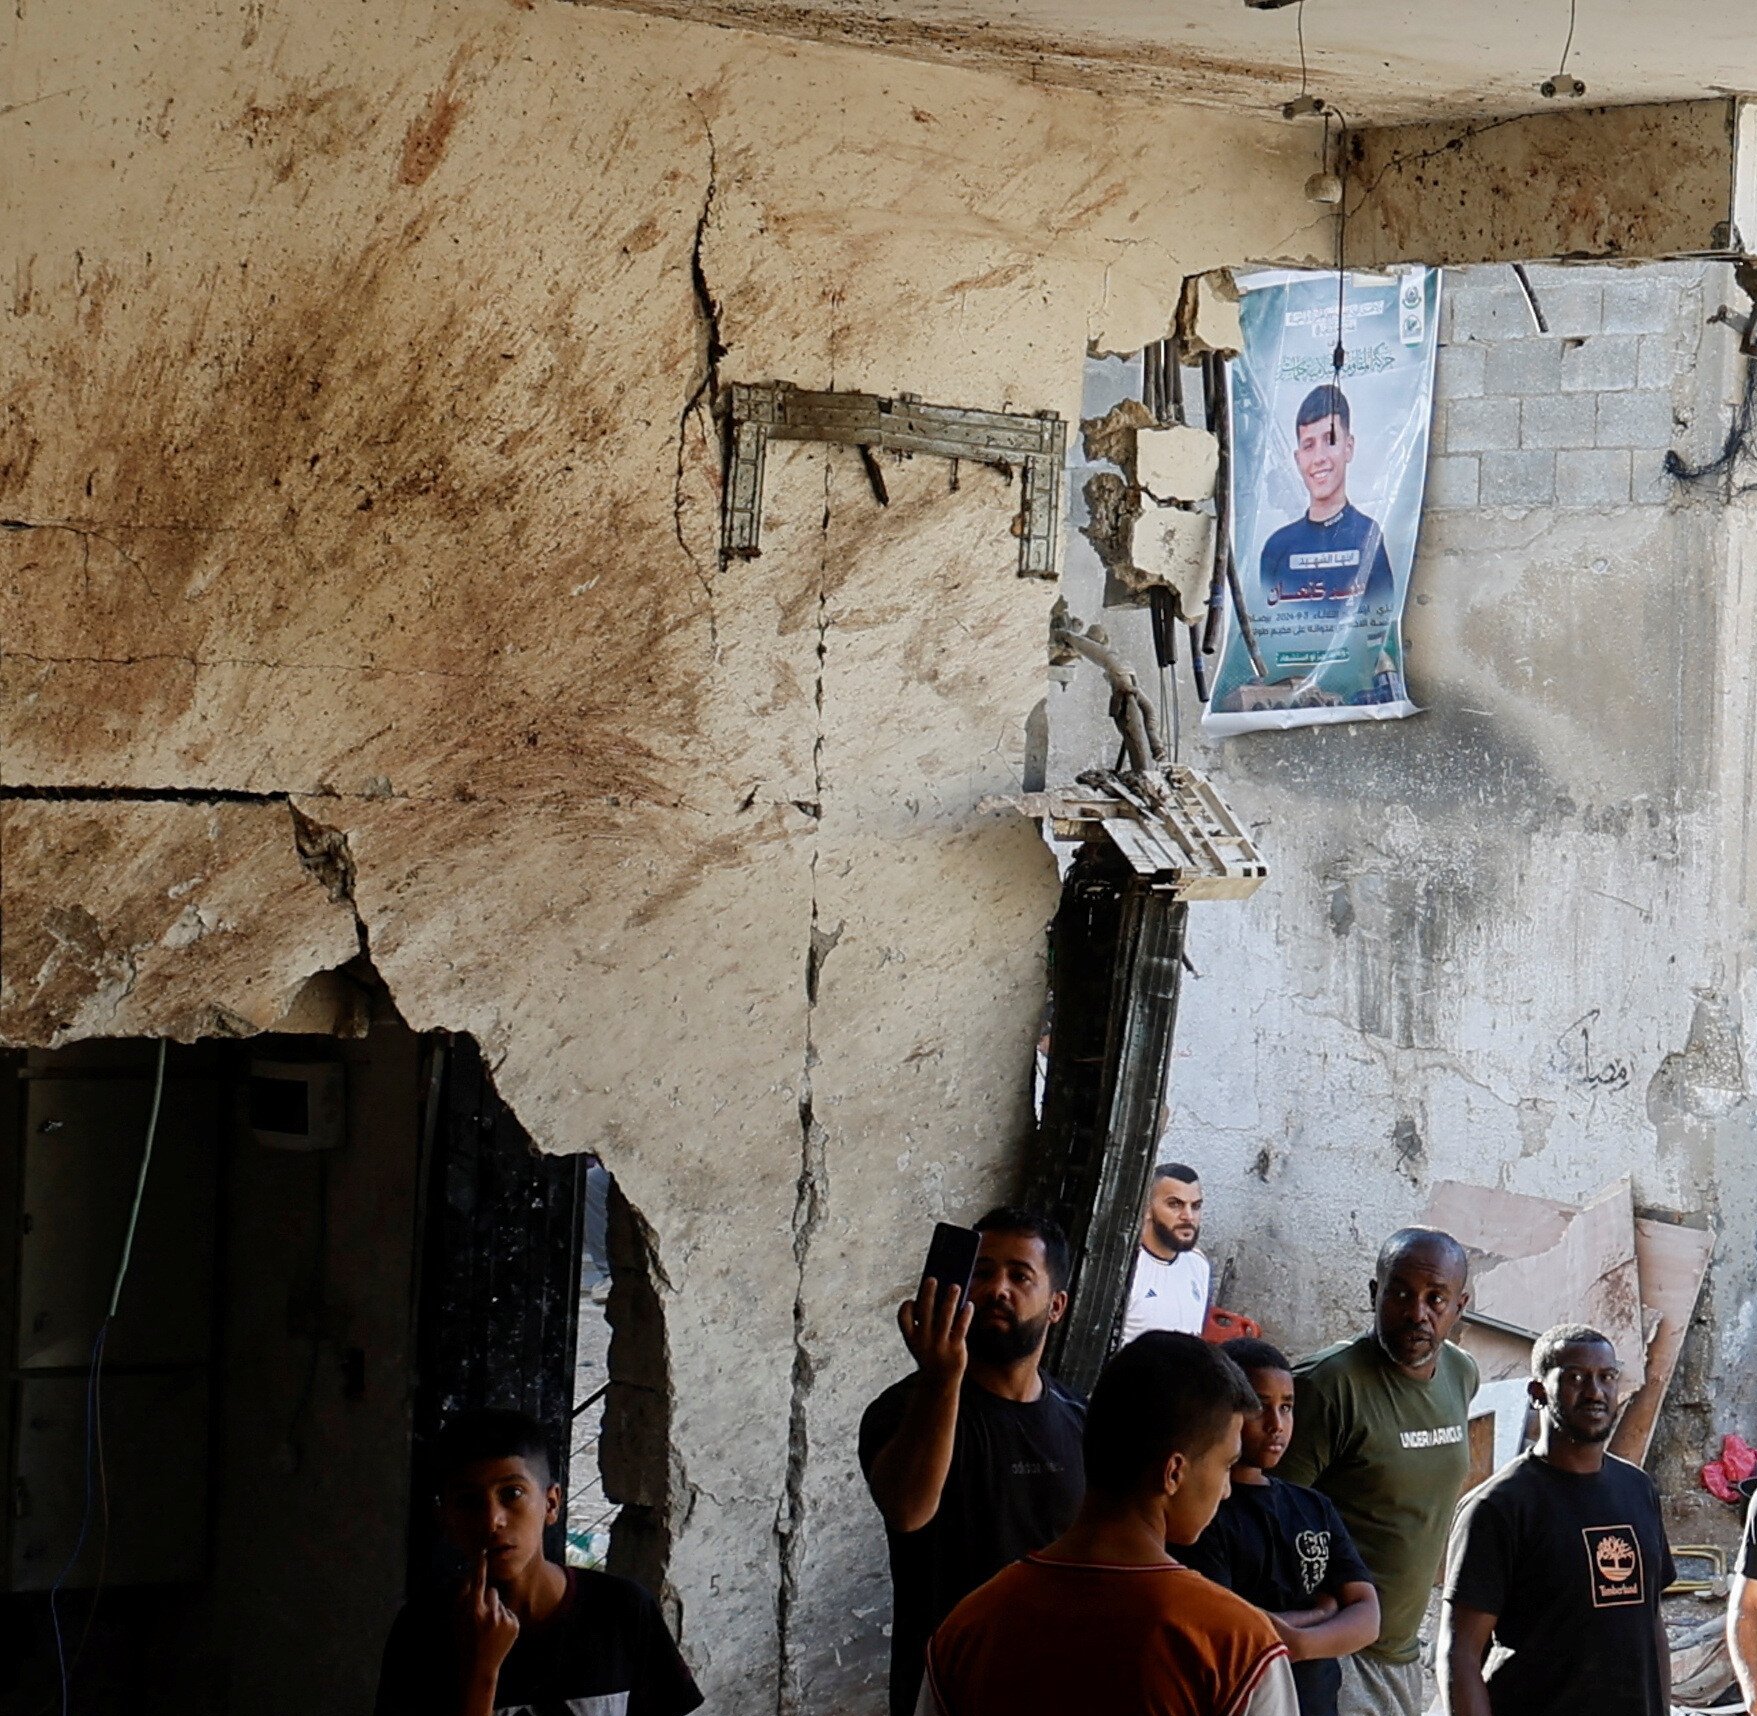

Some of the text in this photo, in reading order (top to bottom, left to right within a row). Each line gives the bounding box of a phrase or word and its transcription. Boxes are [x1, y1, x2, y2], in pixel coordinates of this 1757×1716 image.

[1266, 580, 1325, 608] كنعان
[1399, 1430, 1429, 1449] UNDER
[709, 1573, 722, 1598] 5
